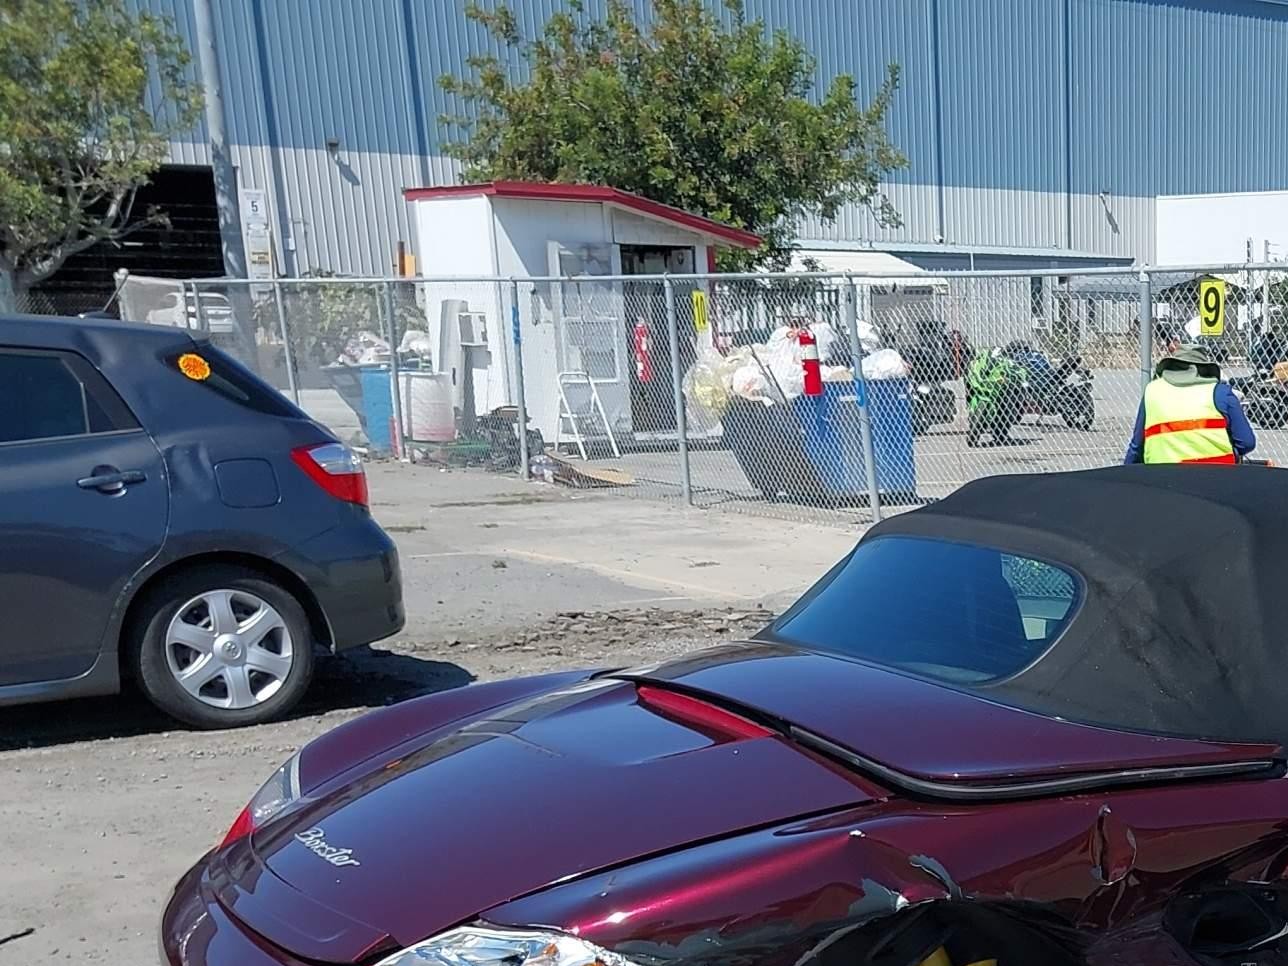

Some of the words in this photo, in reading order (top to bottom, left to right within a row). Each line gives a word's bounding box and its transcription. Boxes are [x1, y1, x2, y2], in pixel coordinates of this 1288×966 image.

[251, 201, 258, 212] 5
[695, 295, 706, 325] 10
[1204, 287, 1220, 327] 9
[294, 827, 361, 867] Boxster
